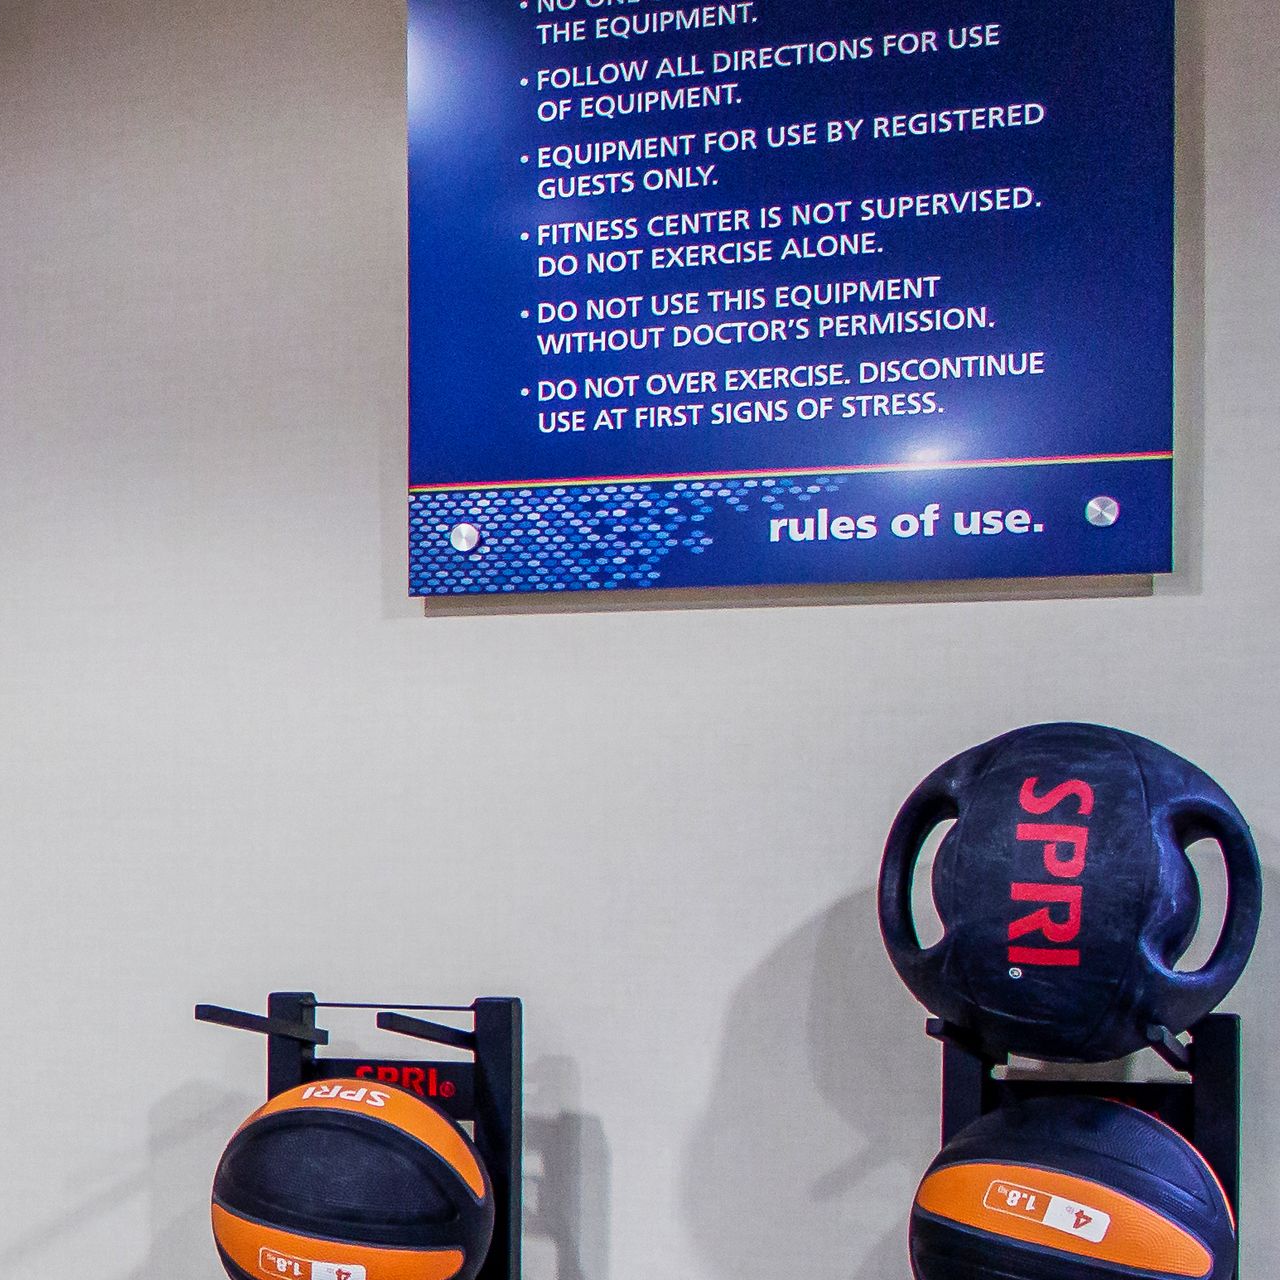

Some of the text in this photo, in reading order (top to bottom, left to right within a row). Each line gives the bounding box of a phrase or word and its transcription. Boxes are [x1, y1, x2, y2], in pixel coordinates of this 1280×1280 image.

[537, 2, 758, 45] THE EQUIPMENT.
[537, 24, 1001, 90] FOLLOW ALL DIRECTIONS FOR USE
[537, 83, 742, 122] OF EQUIPMENT.
[537, 103, 1044, 169] EQUIPMENT FOR USE BY REGISTERED
[537, 165, 718, 199] GUESTS ONLY.
[537, 187, 1041, 245] FITNESS CENTER IS NOT SUPERVISED.
[538, 232, 883, 277] DO NOT EXERCISE ALONE.
[538, 276, 940, 323] DO NOT USE THIS EQUIPMENT
[537, 307, 995, 355] WITHOUT DOCTOR'S PERMISSION.
[538, 352, 1045, 401] DO NOT OVER EXERCISE. DISCONTINUE
[538, 392, 944, 433] USE AT FIRST SIGNS OF STRESS.
[769, 504, 1044, 543] rules of use.
[1008, 776, 1094, 966] SPRI
[302, 1085, 390, 1107] SPRI
[1006, 1190, 1036, 1211] 1.8
[1073, 1209, 1093, 1229] 4
[276, 1257, 303, 1276] 1.8
